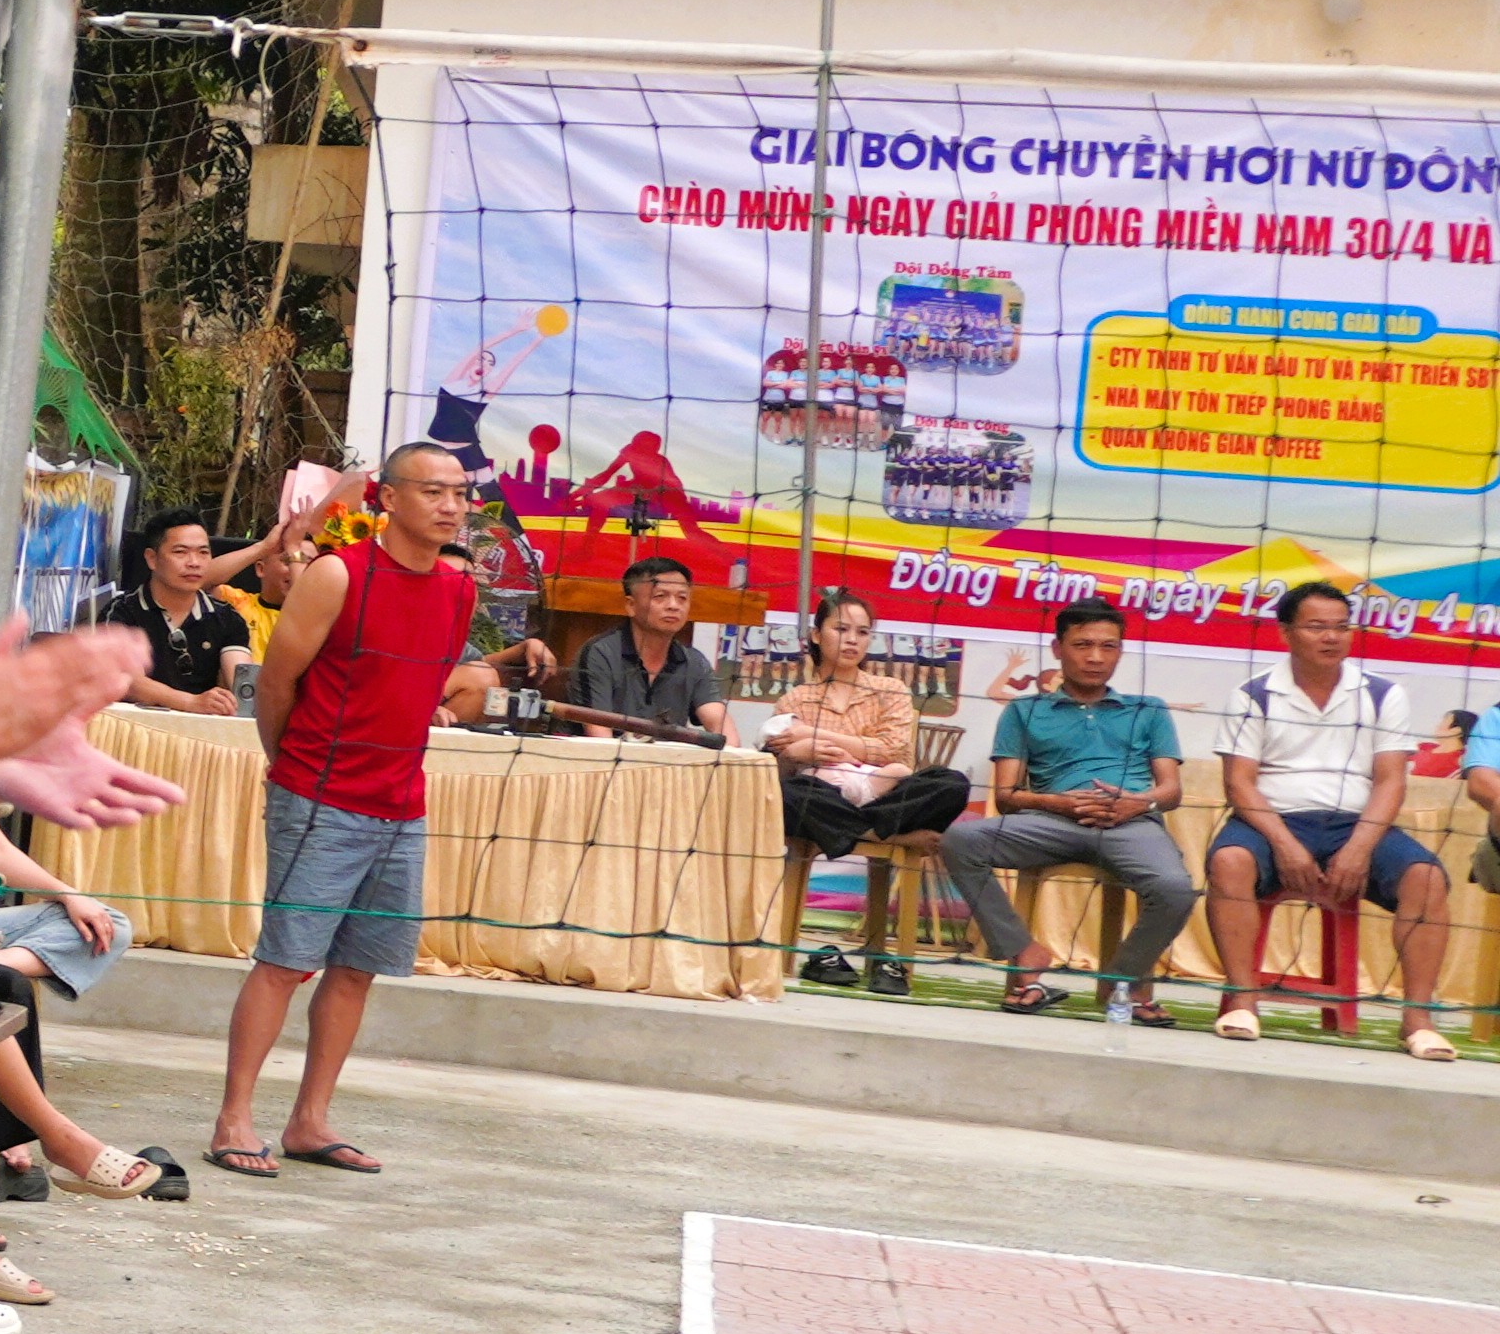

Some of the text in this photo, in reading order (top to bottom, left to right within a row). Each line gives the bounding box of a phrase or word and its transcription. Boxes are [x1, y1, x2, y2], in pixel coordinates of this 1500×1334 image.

[860, 128, 996, 174] BÓNG
[1204, 145, 1295, 186] HƠI
[1307, 146, 1378, 190] NỮ
[638, 180, 726, 228] CHÀO
[846, 191, 936, 238] NGÀY
[945, 192, 1016, 242] GIẢI
[1026, 198, 1143, 249] PHÓNG
[1155, 197, 1242, 253] MIỀN
[1254, 213, 1334, 257] NAM
[1345, 217, 1435, 262] 30/4
[1448, 216, 1493, 265] VÀ
[894, 261, 922, 277] Đội
[1109, 346, 1142, 368] CTY
[1146, 348, 1191, 371] TNHH
[1224, 346, 1258, 375] VẤN
[1187, 387, 1220, 413] TÔN
[1273, 396, 1332, 421] PHONG
[1216, 432, 1257, 456] GIAN
[1263, 436, 1323, 461] COFFEE
[889, 546, 998, 608] Đồng
[1118, 570, 1229, 626] ngày
[1239, 578, 1286, 620] 12
[1429, 591, 1460, 633] 4
